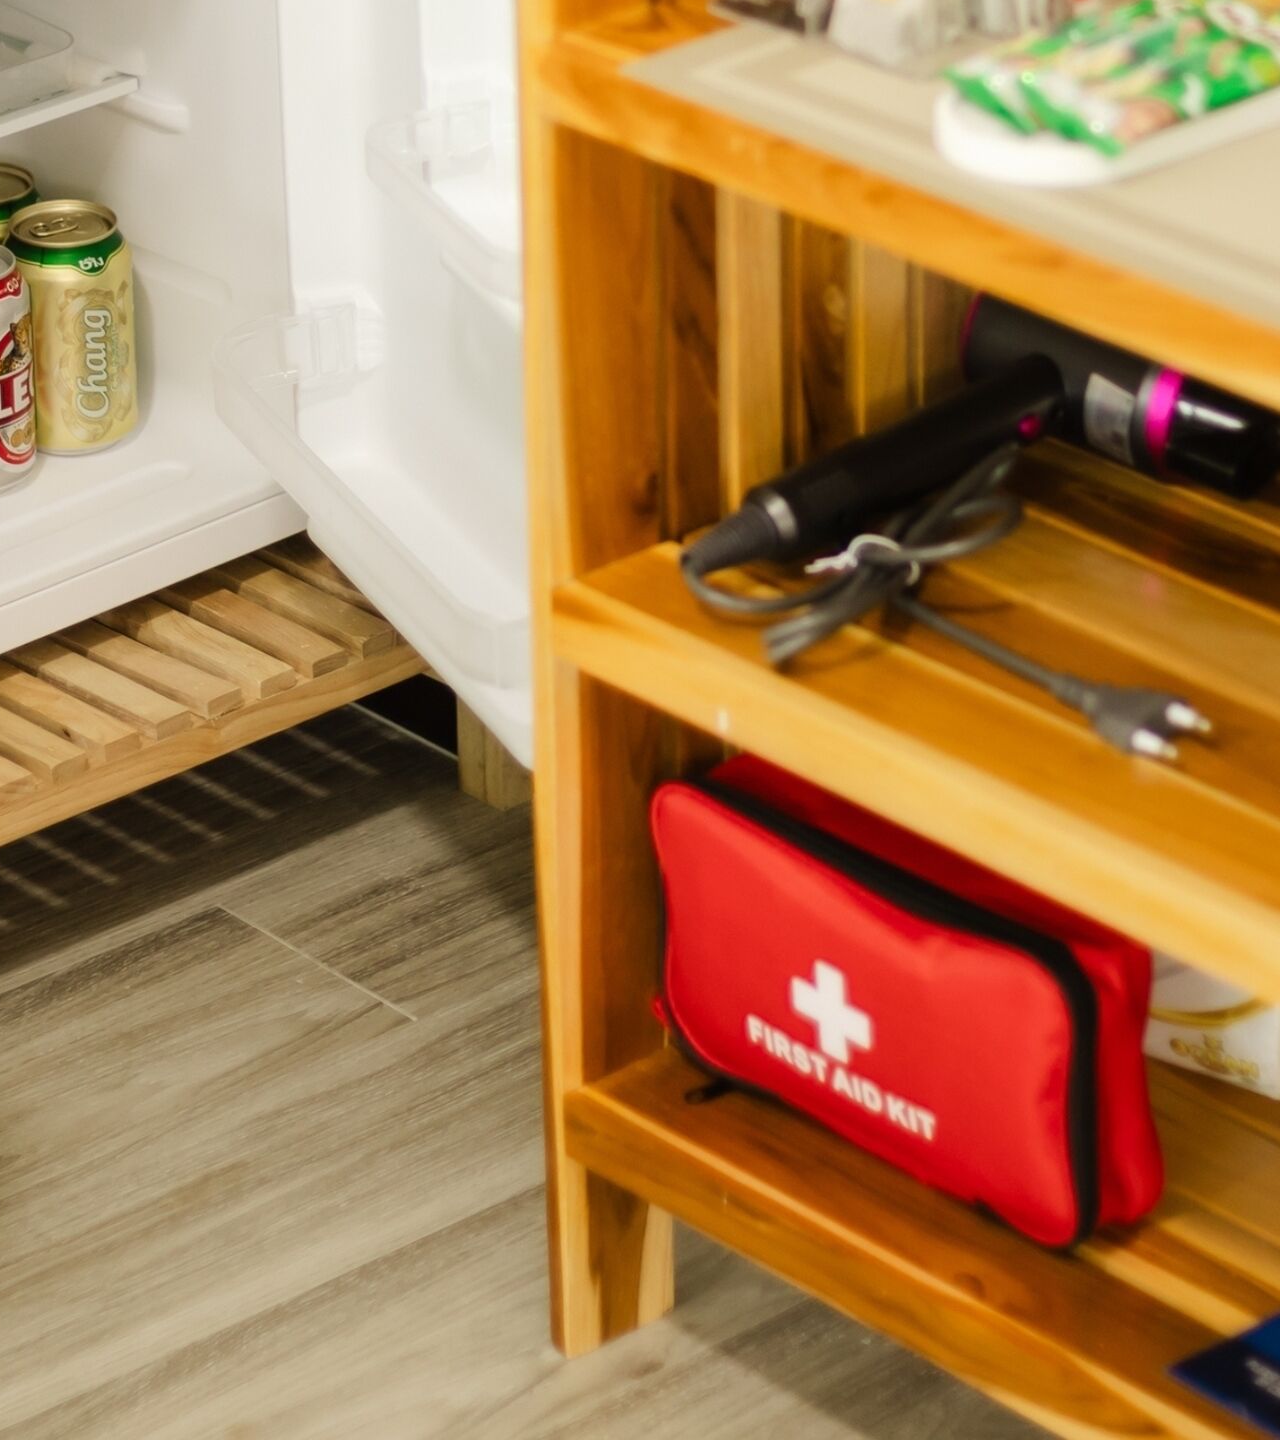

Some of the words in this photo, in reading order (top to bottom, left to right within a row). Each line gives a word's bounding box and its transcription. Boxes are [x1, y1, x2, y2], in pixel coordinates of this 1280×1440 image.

[75, 309, 112, 421] Chang
[746, 1012, 827, 1085] FIRST
[832, 1065, 882, 1114] AID
[886, 1093, 936, 1142] KIT
